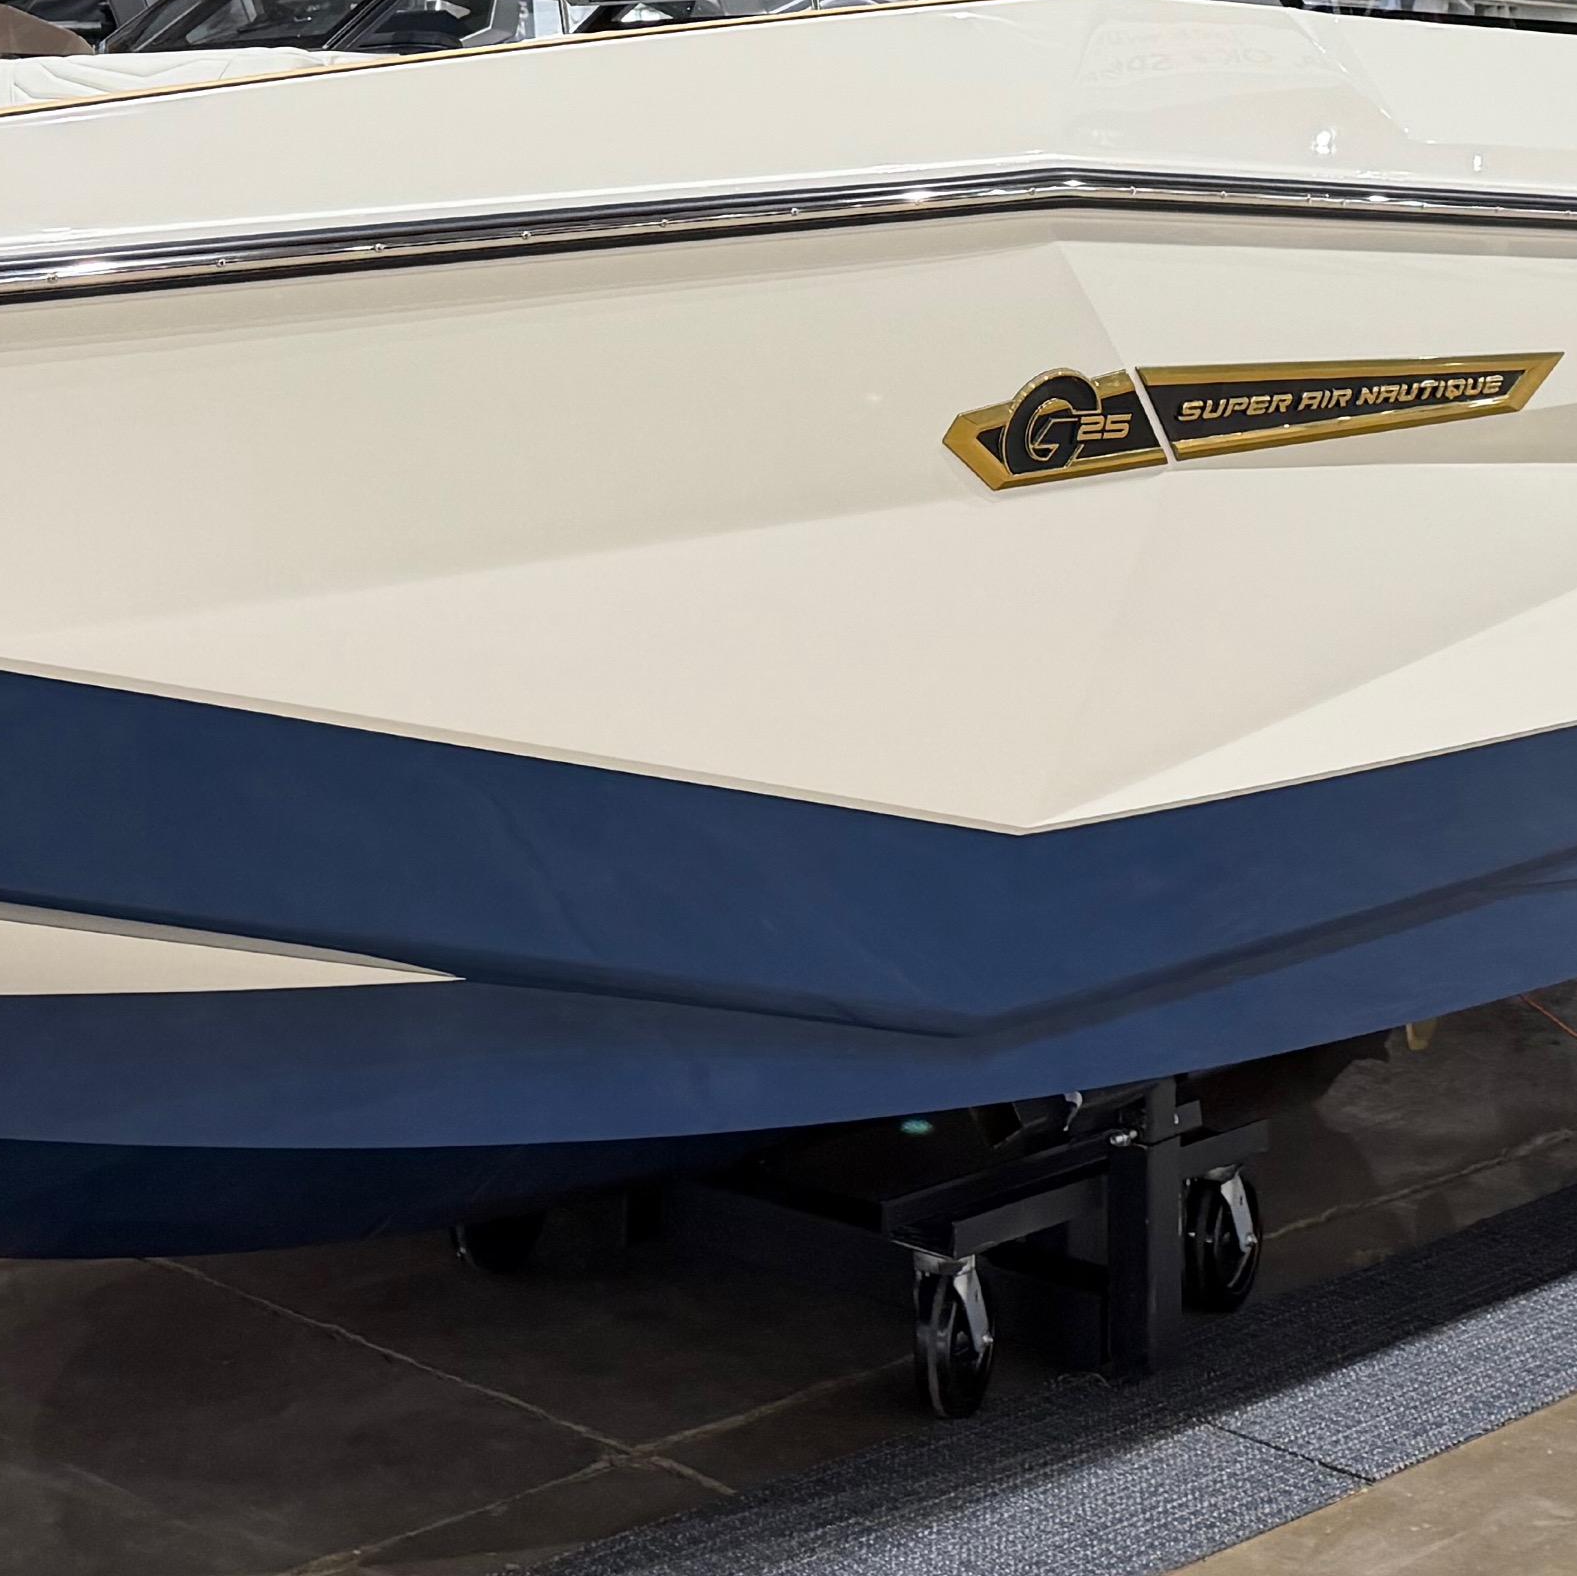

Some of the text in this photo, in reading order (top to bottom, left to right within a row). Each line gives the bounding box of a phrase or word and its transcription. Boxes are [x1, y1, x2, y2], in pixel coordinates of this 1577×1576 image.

[1178, 374, 1504, 421] SUPER AIR NAUTIQUE
